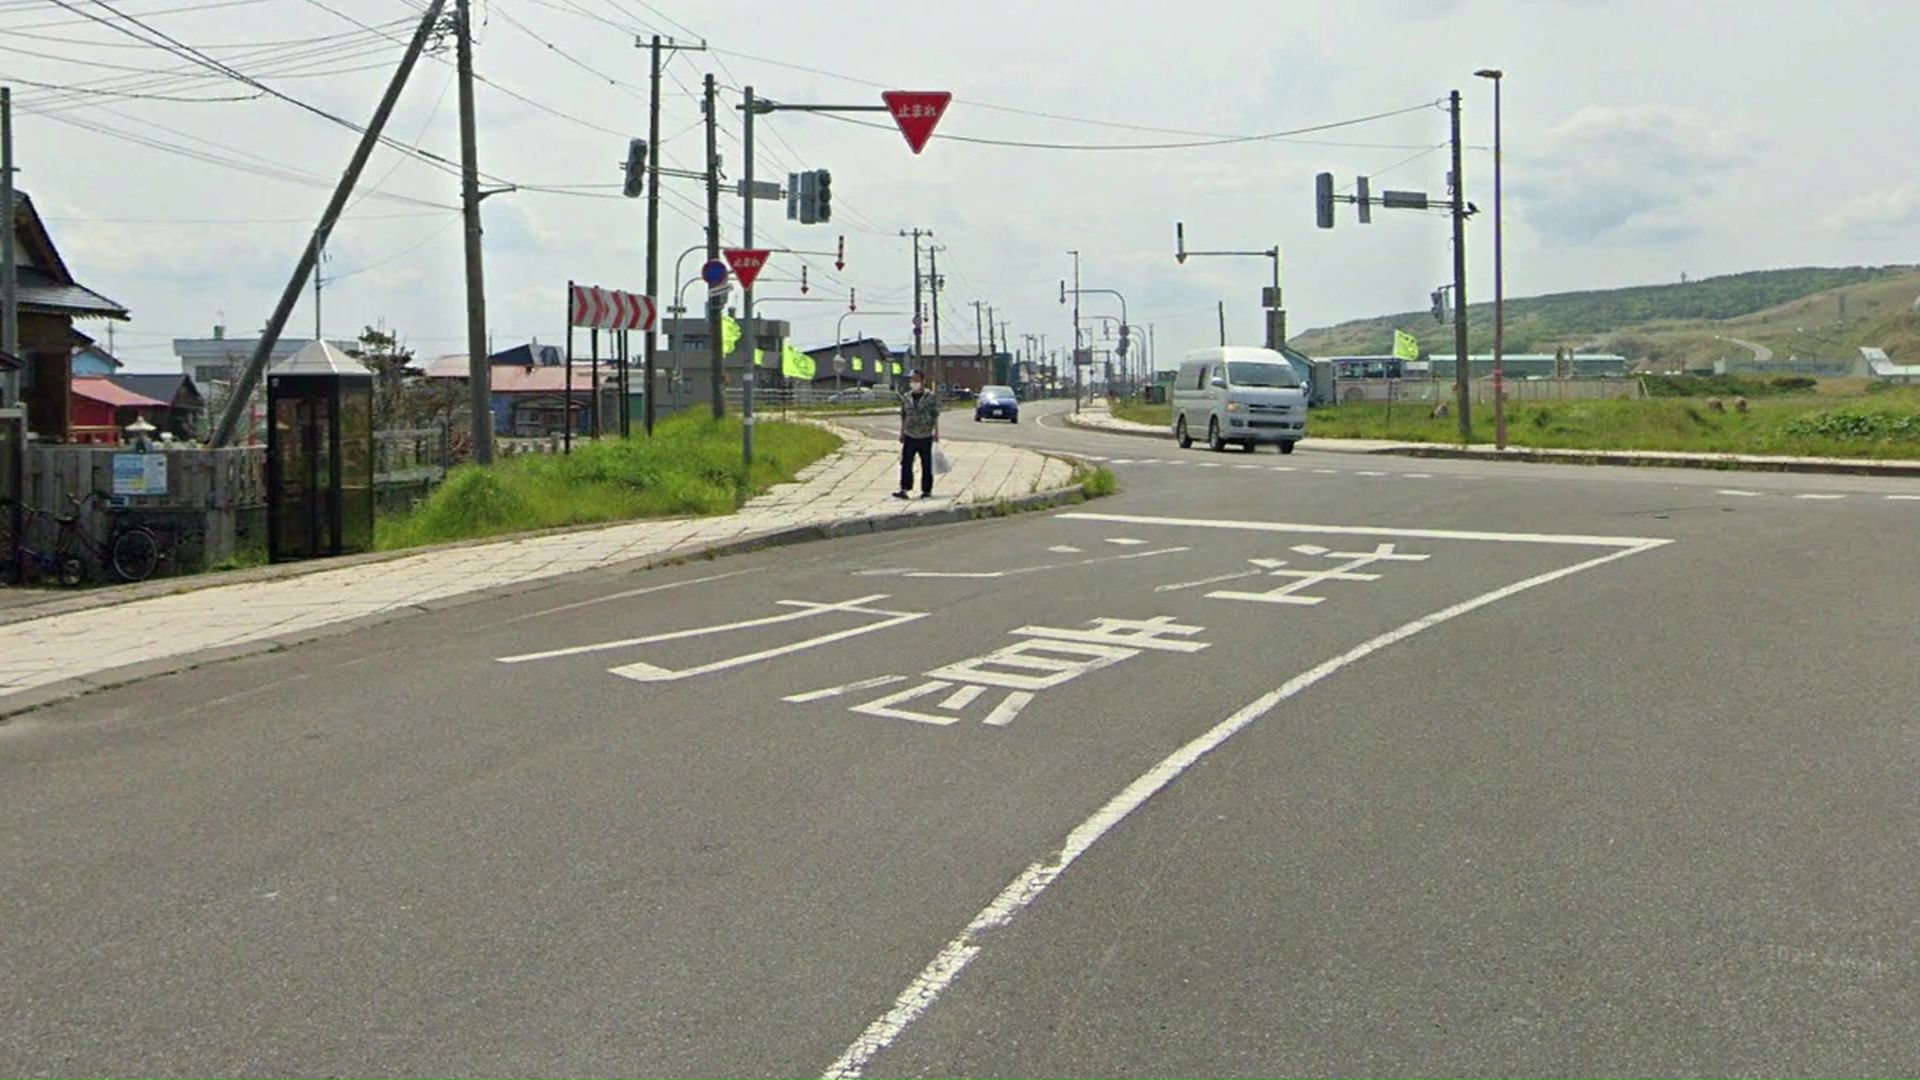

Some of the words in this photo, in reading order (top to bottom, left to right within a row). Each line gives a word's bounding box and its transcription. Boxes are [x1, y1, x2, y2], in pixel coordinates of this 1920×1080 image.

[898, 103, 936, 118] 止まれ
[733, 256, 761, 268] 止まれ
